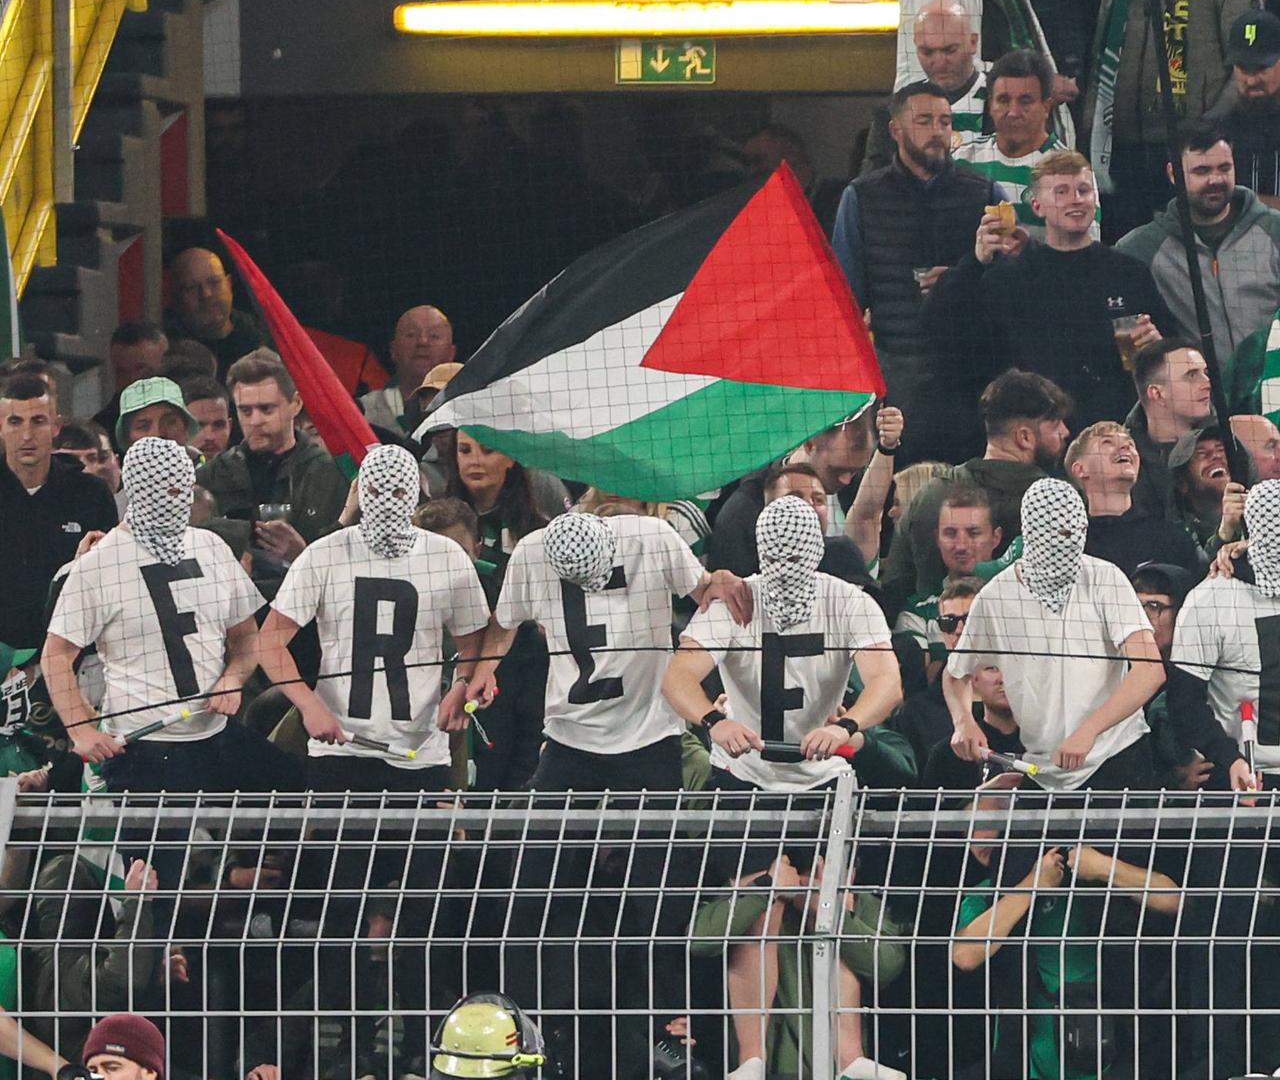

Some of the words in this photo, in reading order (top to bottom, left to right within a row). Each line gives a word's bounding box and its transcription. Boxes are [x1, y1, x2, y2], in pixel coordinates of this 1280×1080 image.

[141, 558, 204, 697] F
[349, 577, 418, 721] R
[565, 566, 625, 703] E
